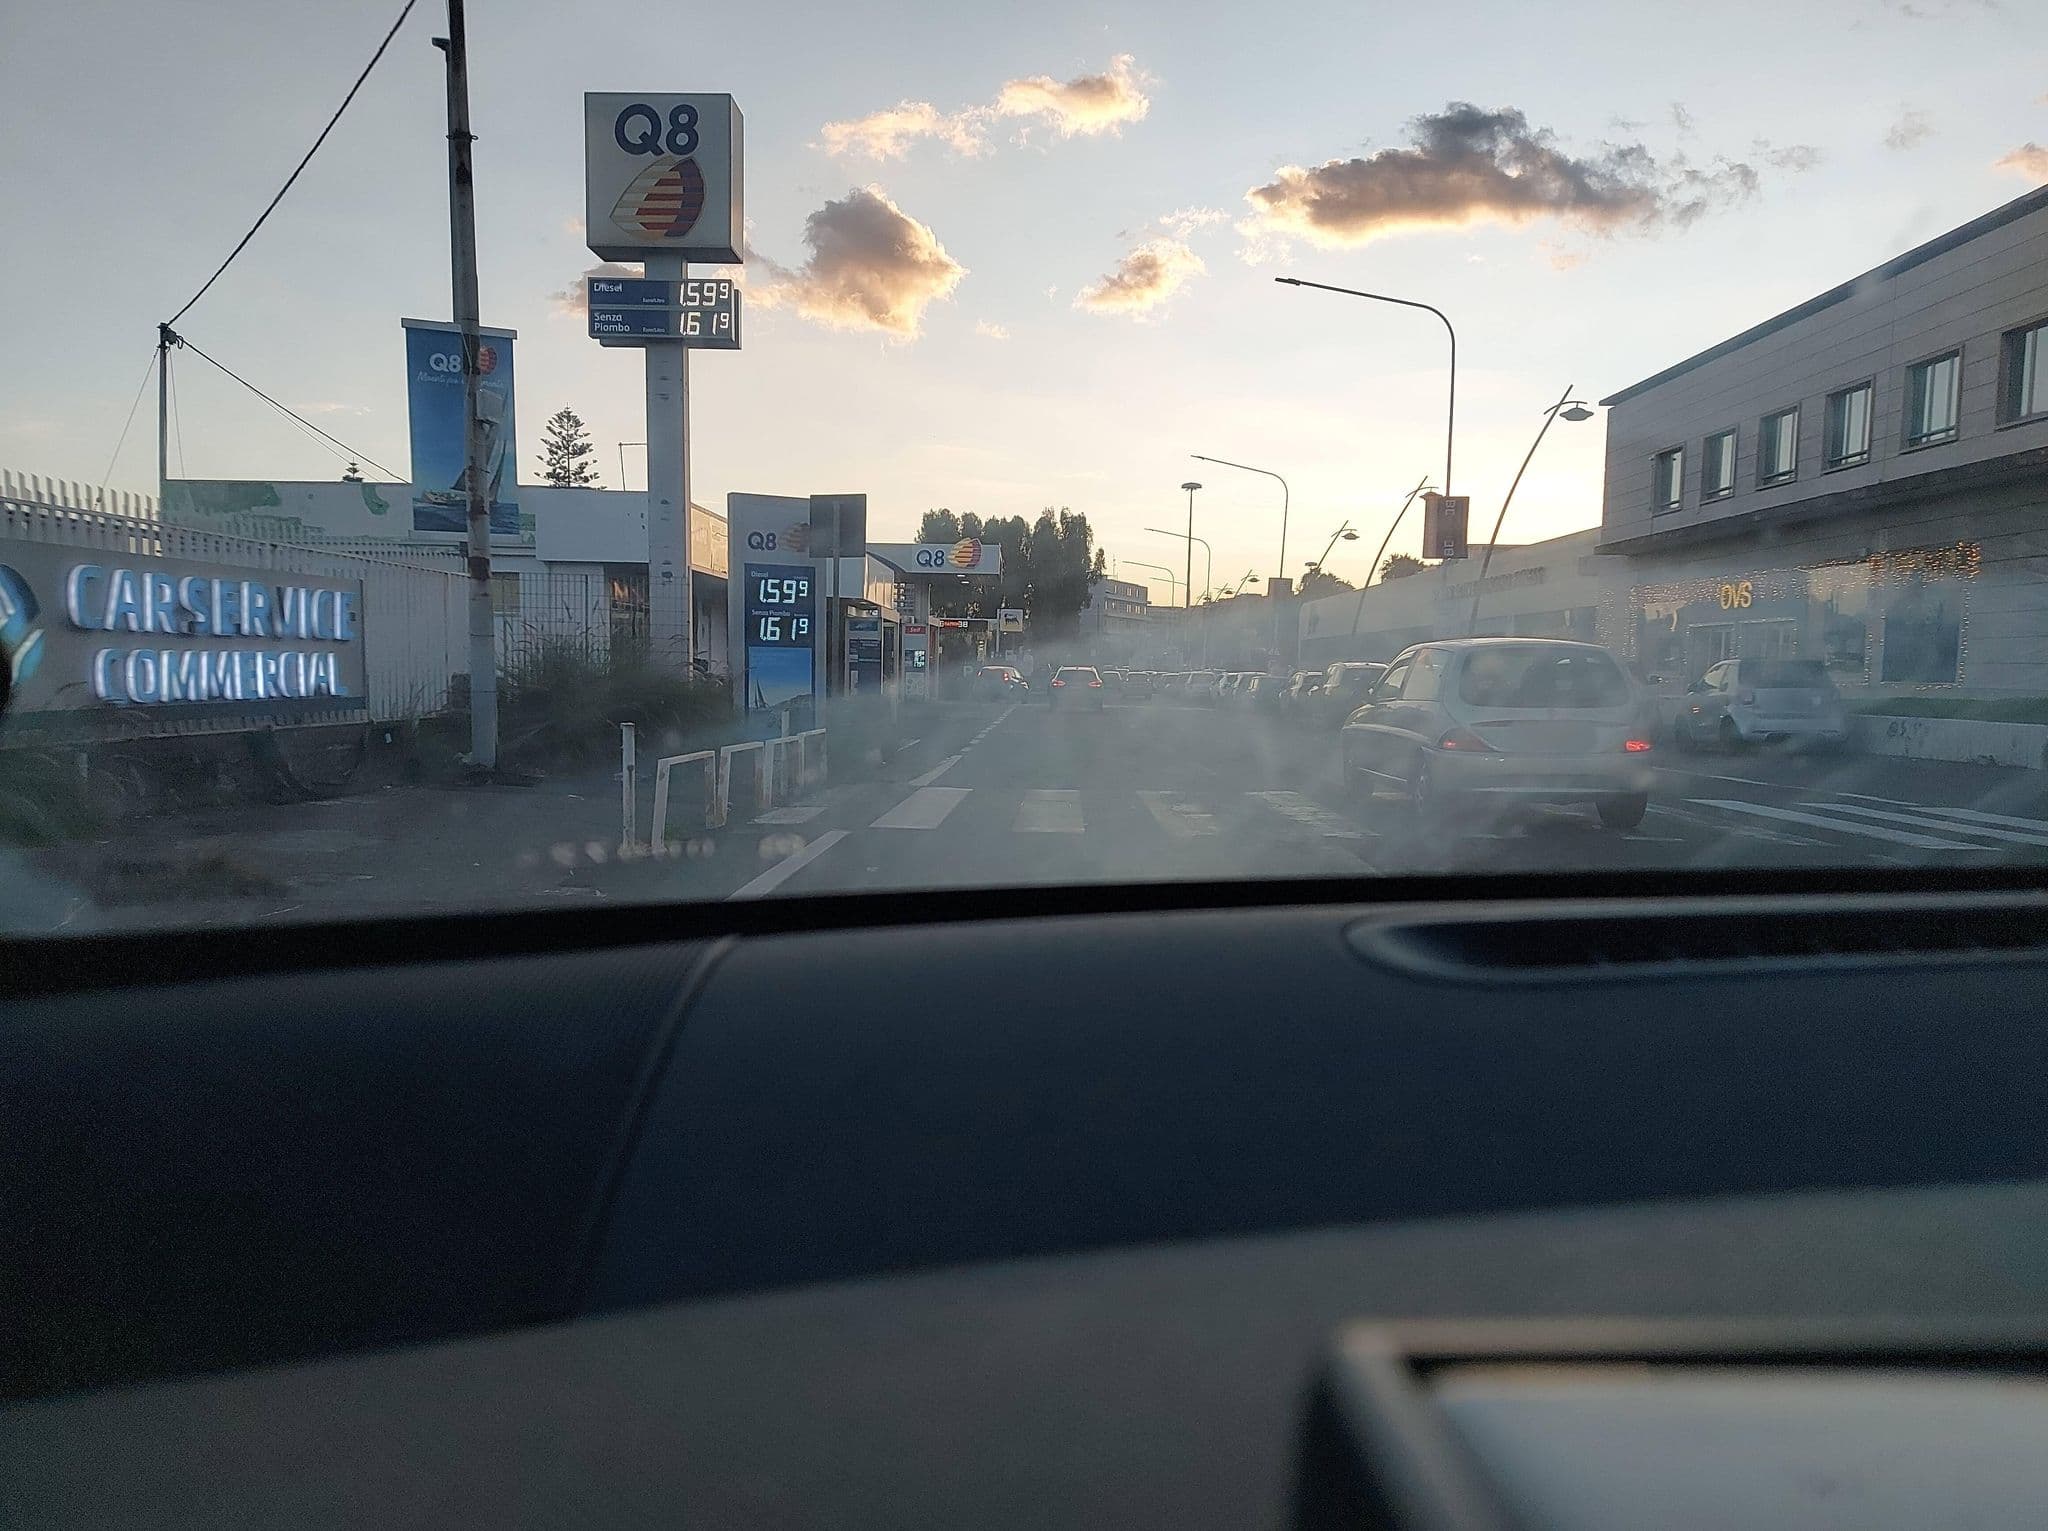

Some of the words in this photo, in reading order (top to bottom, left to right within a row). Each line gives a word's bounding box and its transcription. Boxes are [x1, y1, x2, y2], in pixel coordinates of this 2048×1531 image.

[614, 103, 700, 155] Q8
[593, 283, 623, 292] Diesel
[594, 312, 623, 322] Senza
[594, 323, 631, 333] Piombo
[429, 352, 461, 373] Q8
[747, 531, 777, 551] Q8
[916, 549, 945, 567] Q8
[1720, 580, 1753, 610] OVS
[95, 647, 348, 703] COMMERCIAL
